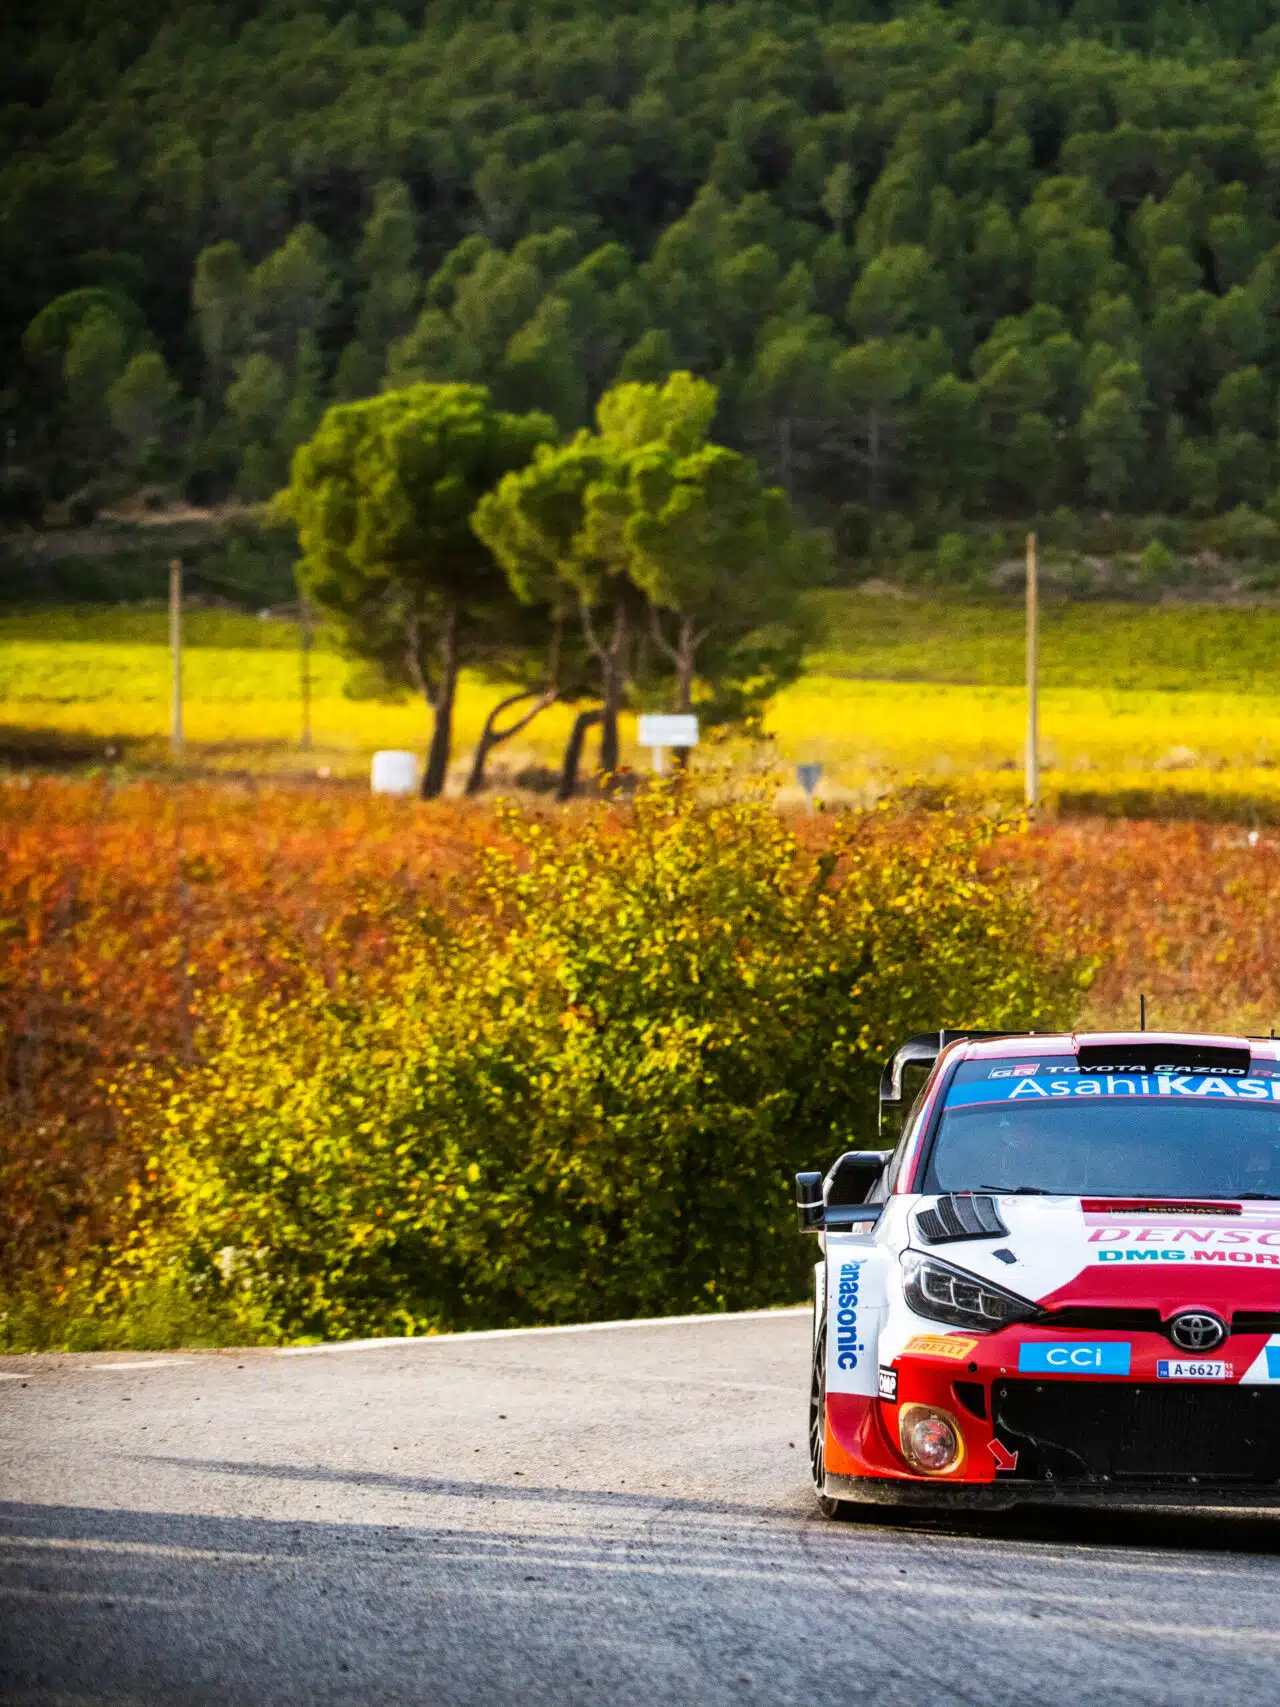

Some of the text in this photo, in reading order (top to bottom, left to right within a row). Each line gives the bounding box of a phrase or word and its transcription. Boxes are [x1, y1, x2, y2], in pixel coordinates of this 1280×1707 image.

[989, 1066, 1038, 1078] GR
[1045, 1064, 1146, 1074] TOYOTA
[1152, 1064, 1246, 1075] GAZOO
[1098, 1250, 1186, 1262] DMG
[1174, 1363, 1222, 1376] A-6627
